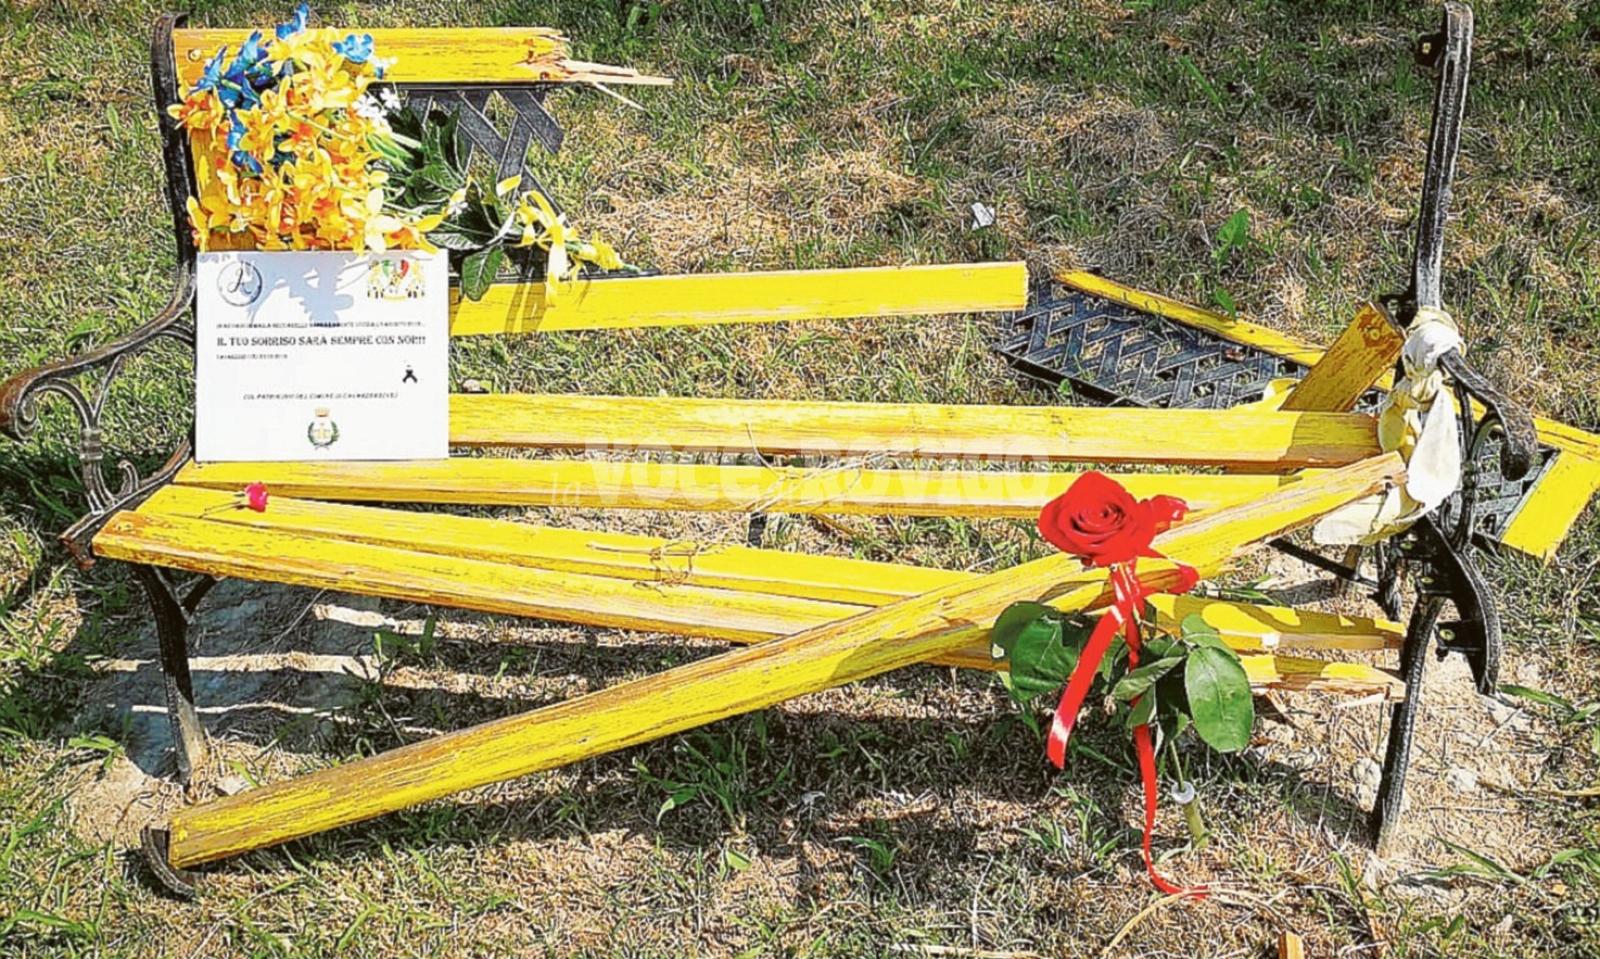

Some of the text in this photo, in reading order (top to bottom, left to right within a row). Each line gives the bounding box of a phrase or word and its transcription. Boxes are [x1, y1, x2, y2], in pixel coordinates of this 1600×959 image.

[216, 336, 227, 346] IL
[230, 336, 248, 346] TUO
[251, 335, 296, 346] SORRISO
[330, 335, 373, 346] SEMPRE
[375, 335, 395, 345] CON
